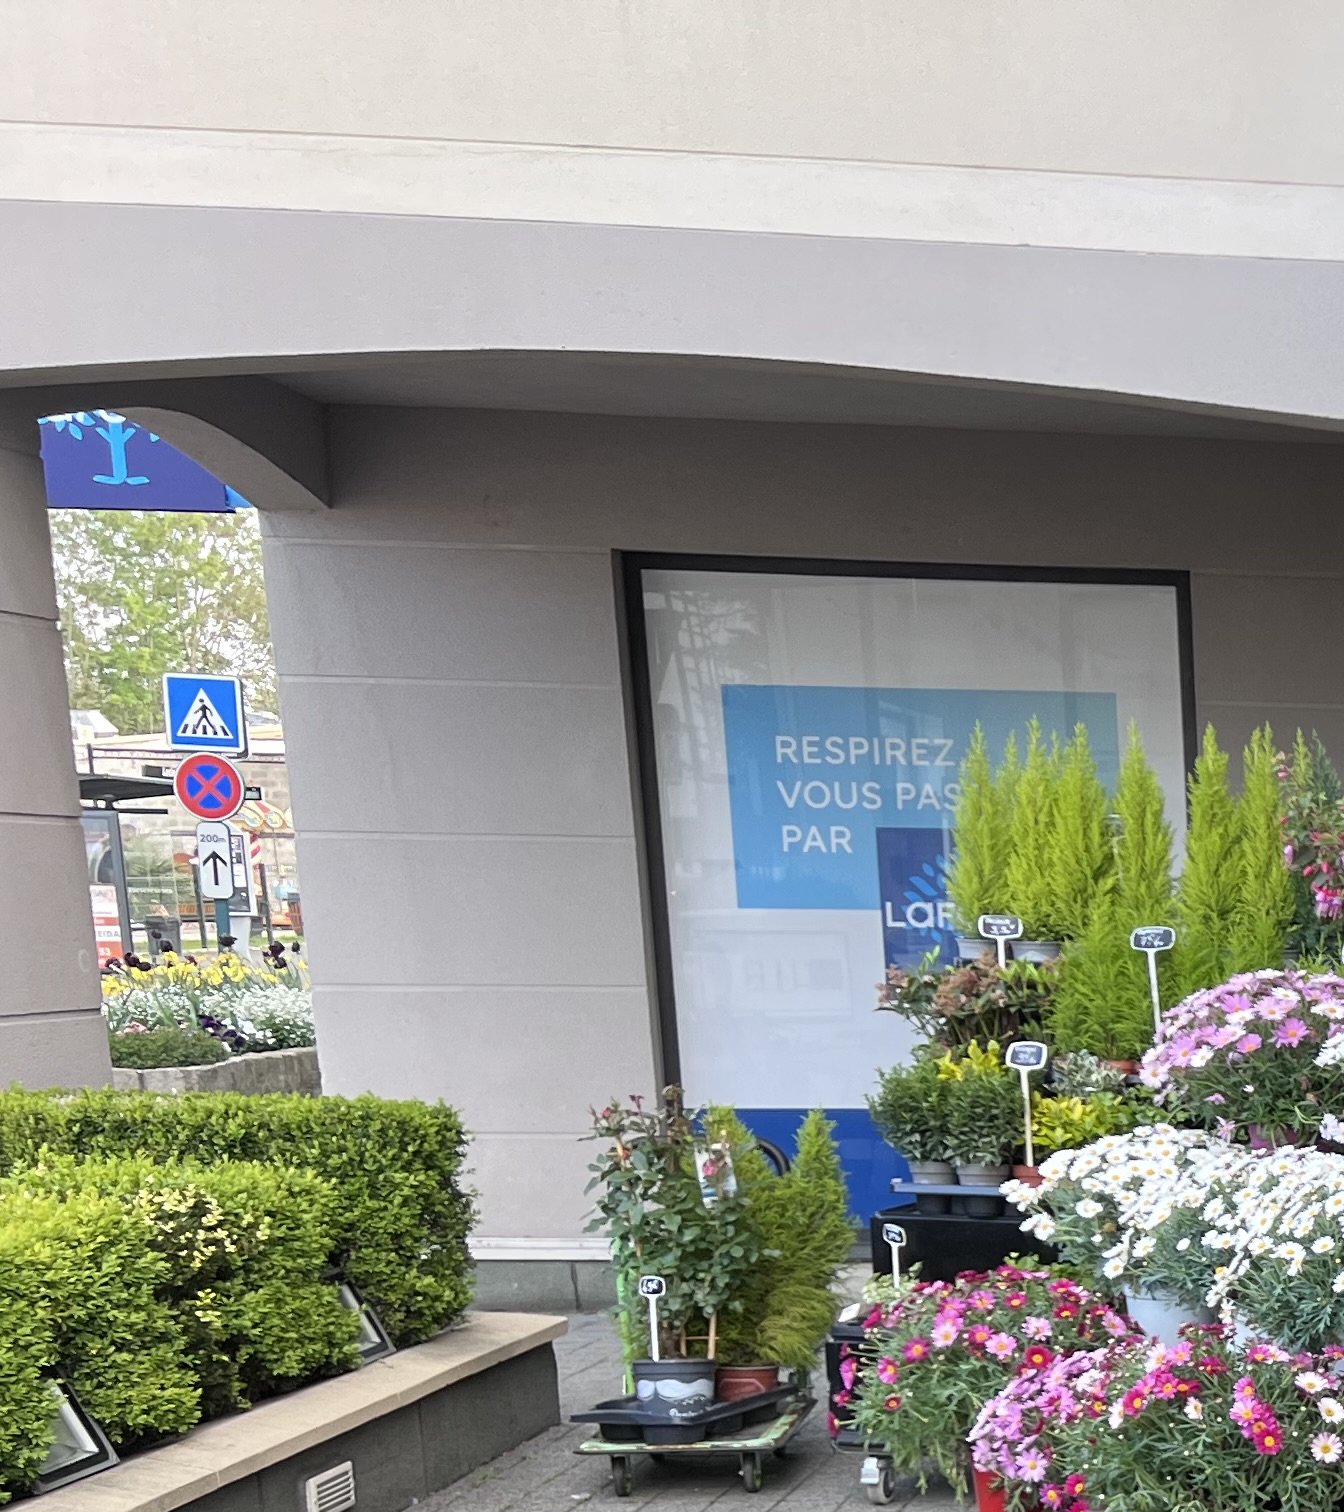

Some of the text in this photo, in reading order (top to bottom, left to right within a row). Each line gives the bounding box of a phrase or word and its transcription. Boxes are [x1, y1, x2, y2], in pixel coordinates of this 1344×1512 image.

[776, 780, 980, 811] VOUS PAS
[199, 833, 226, 843] 200m
[781, 824, 853, 854] PAR
